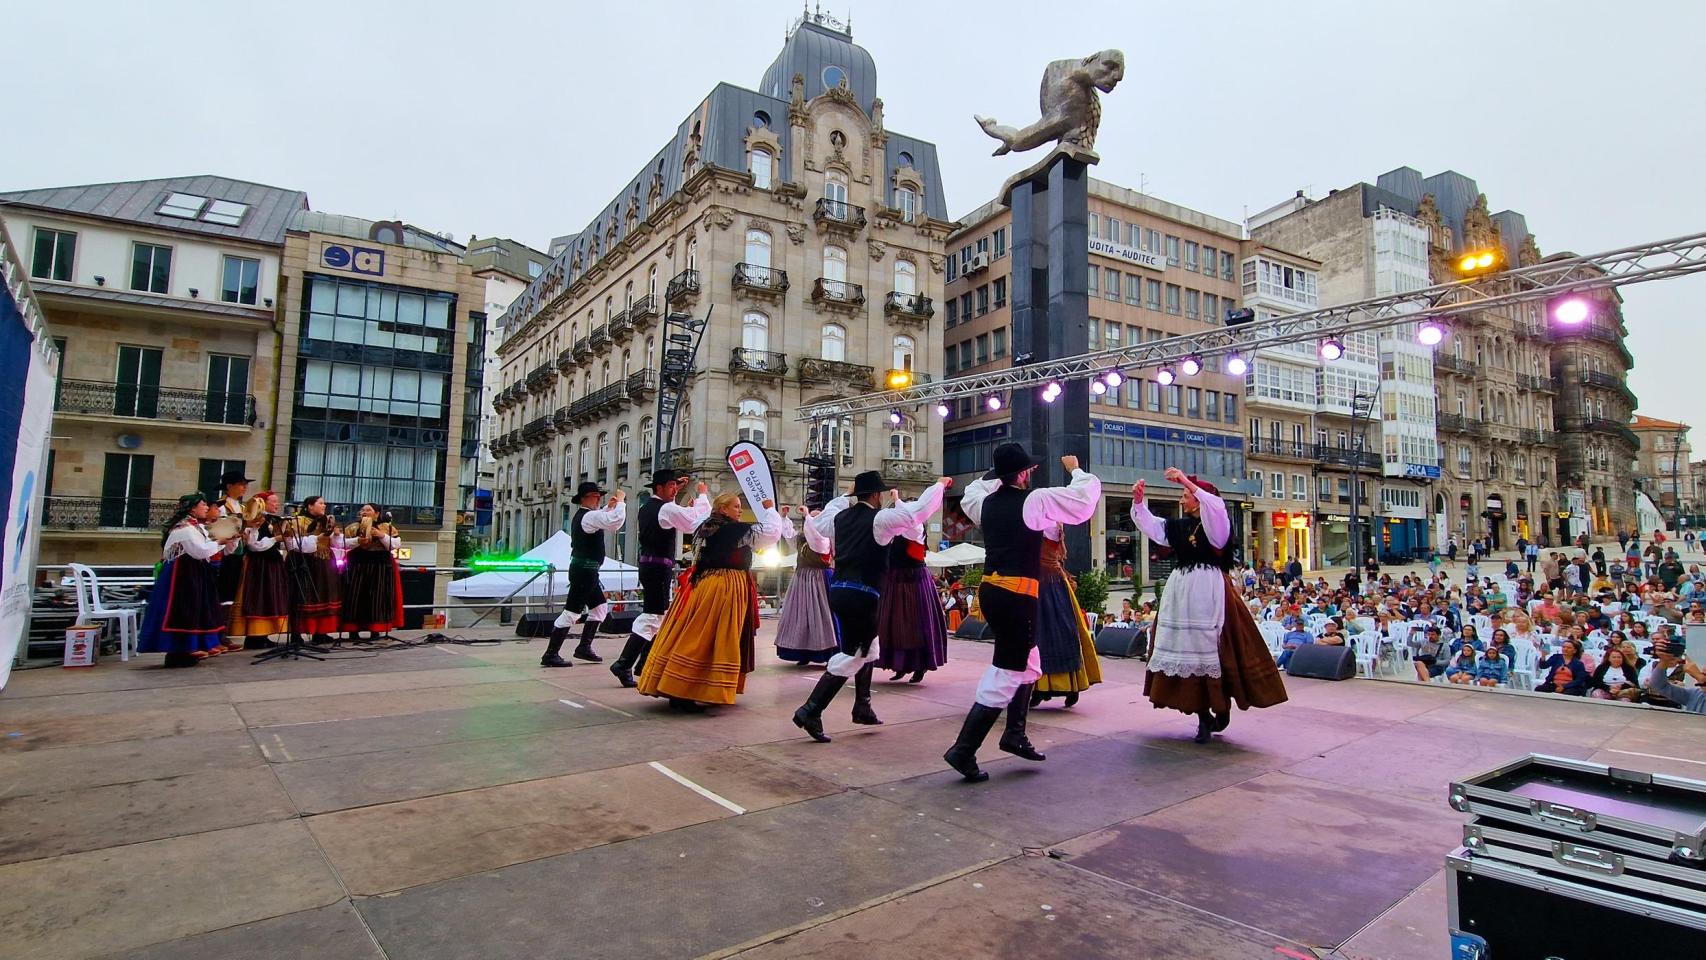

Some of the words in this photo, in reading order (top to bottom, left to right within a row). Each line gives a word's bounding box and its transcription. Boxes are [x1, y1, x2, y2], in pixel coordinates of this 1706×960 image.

[1089, 241, 1114, 254] UDITA
[1122, 250, 1156, 265] AUDITEC
[1104, 423, 1124, 431] OCASO
